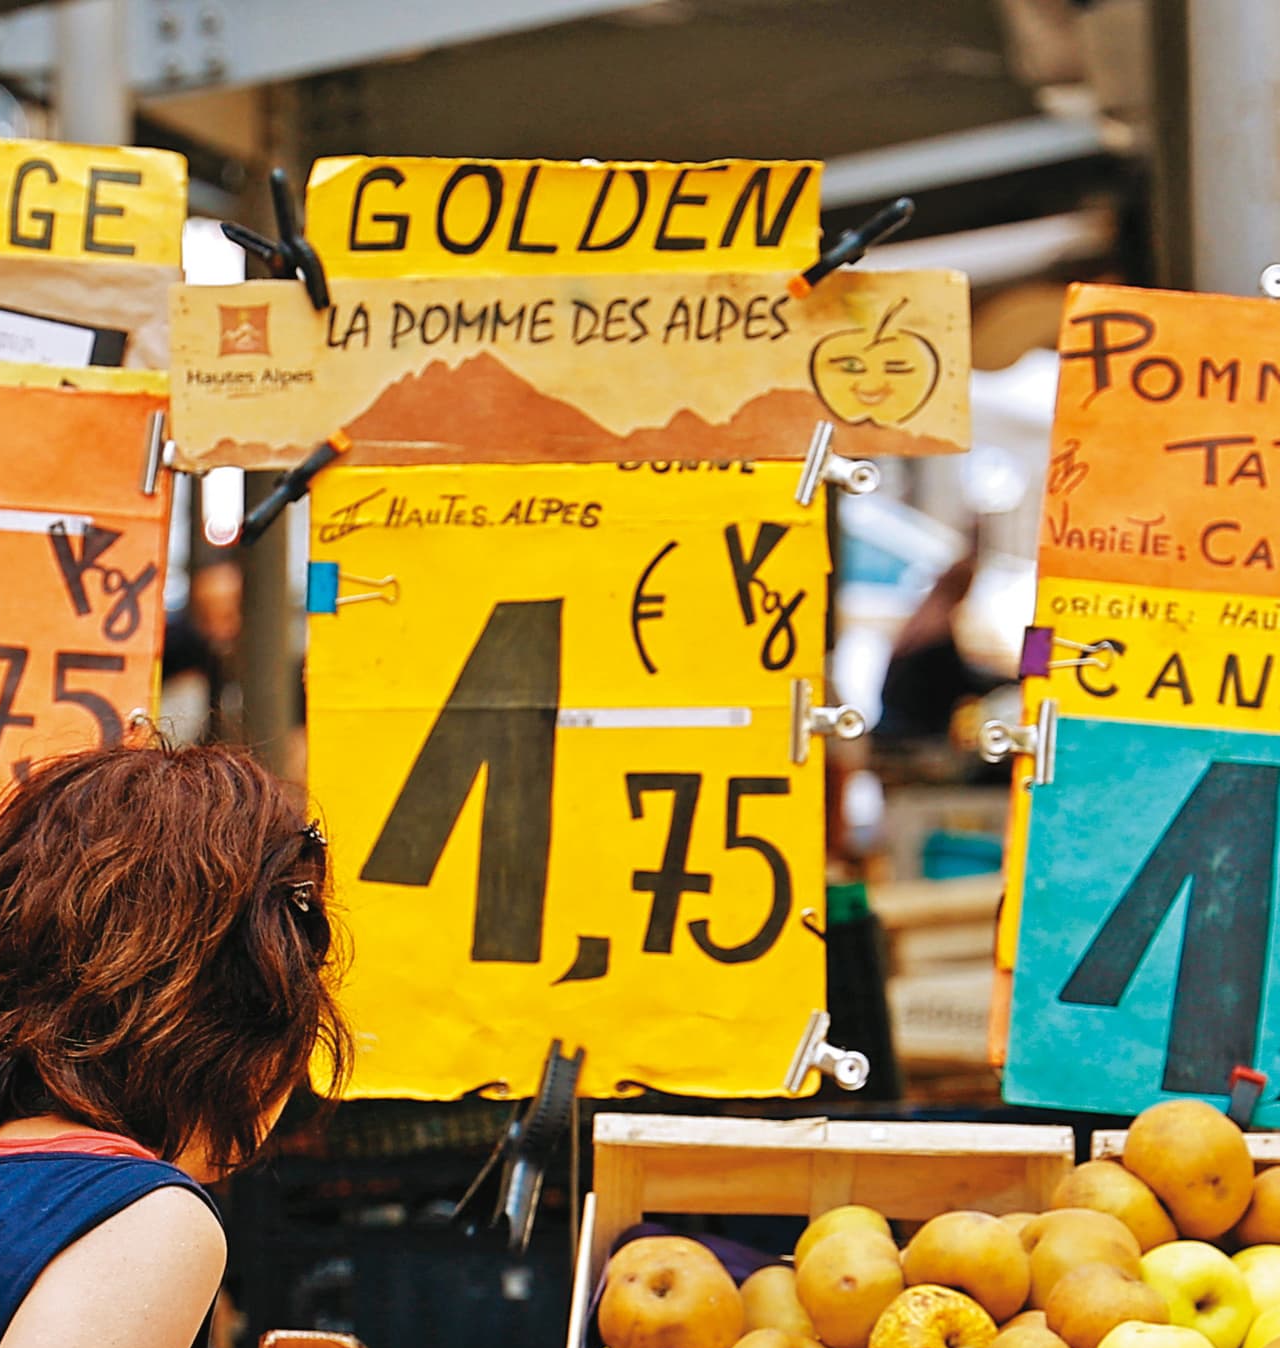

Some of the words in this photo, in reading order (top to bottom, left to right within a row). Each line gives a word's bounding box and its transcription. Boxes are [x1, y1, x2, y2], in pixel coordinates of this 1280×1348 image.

[349, 163, 814, 255] GOLDEN
[326, 301, 370, 351] LA
[391, 301, 553, 348] POMME
[573, 296, 651, 345] DES
[664, 294, 790, 344] ALPES
[186, 369, 254, 385] Hautes
[260, 368, 315, 387] Alpes
[502, 496, 603, 530] ALPES
[724, 522, 808, 671] Kg
